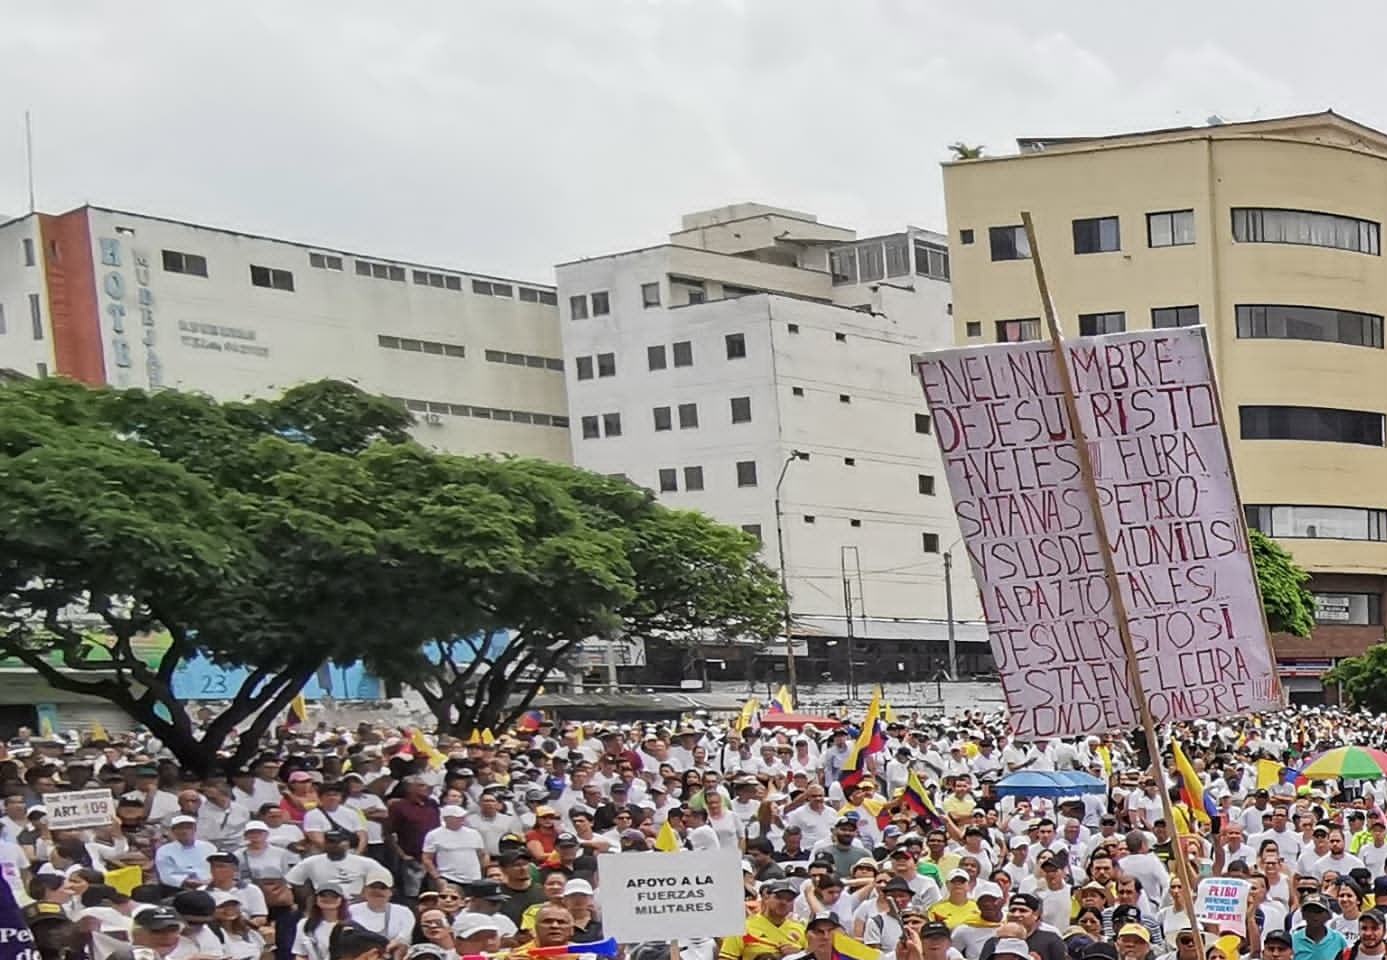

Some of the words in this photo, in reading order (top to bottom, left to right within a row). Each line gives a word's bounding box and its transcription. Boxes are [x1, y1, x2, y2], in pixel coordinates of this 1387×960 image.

[100, 238, 132, 370] HOTE
[955, 488, 1083, 538] SATANAS
[989, 611, 1195, 670] JESUCRSTO
[202, 675, 228, 693] 23
[626, 877, 677, 888] APOYO
[681, 876, 693, 886] A
[695, 875, 714, 885] LA
[637, 889, 706, 902] FUERZAS
[635, 902, 714, 915] MILITARES
